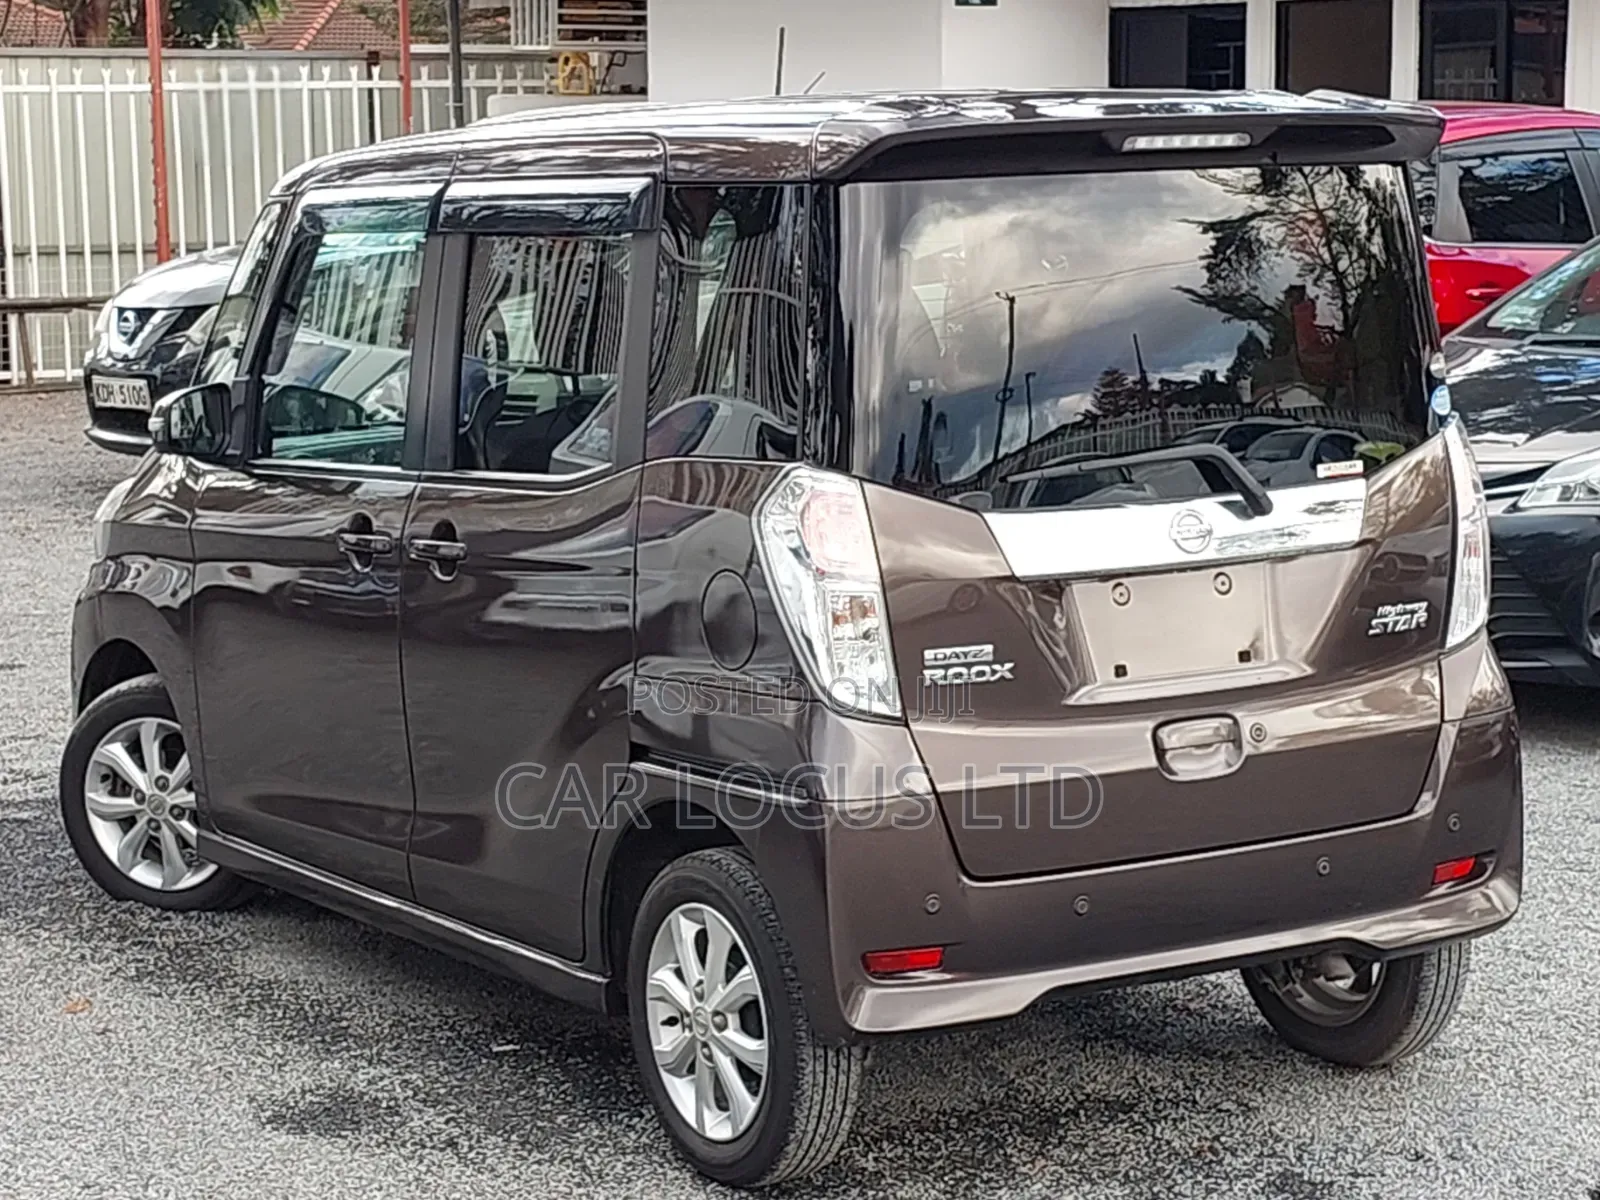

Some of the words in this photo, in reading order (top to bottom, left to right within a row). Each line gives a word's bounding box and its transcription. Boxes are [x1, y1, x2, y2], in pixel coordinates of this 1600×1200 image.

[1368, 612, 1428, 636] STAR
[932, 647, 992, 662] DAYZ
[922, 662, 1015, 686] ROOX
